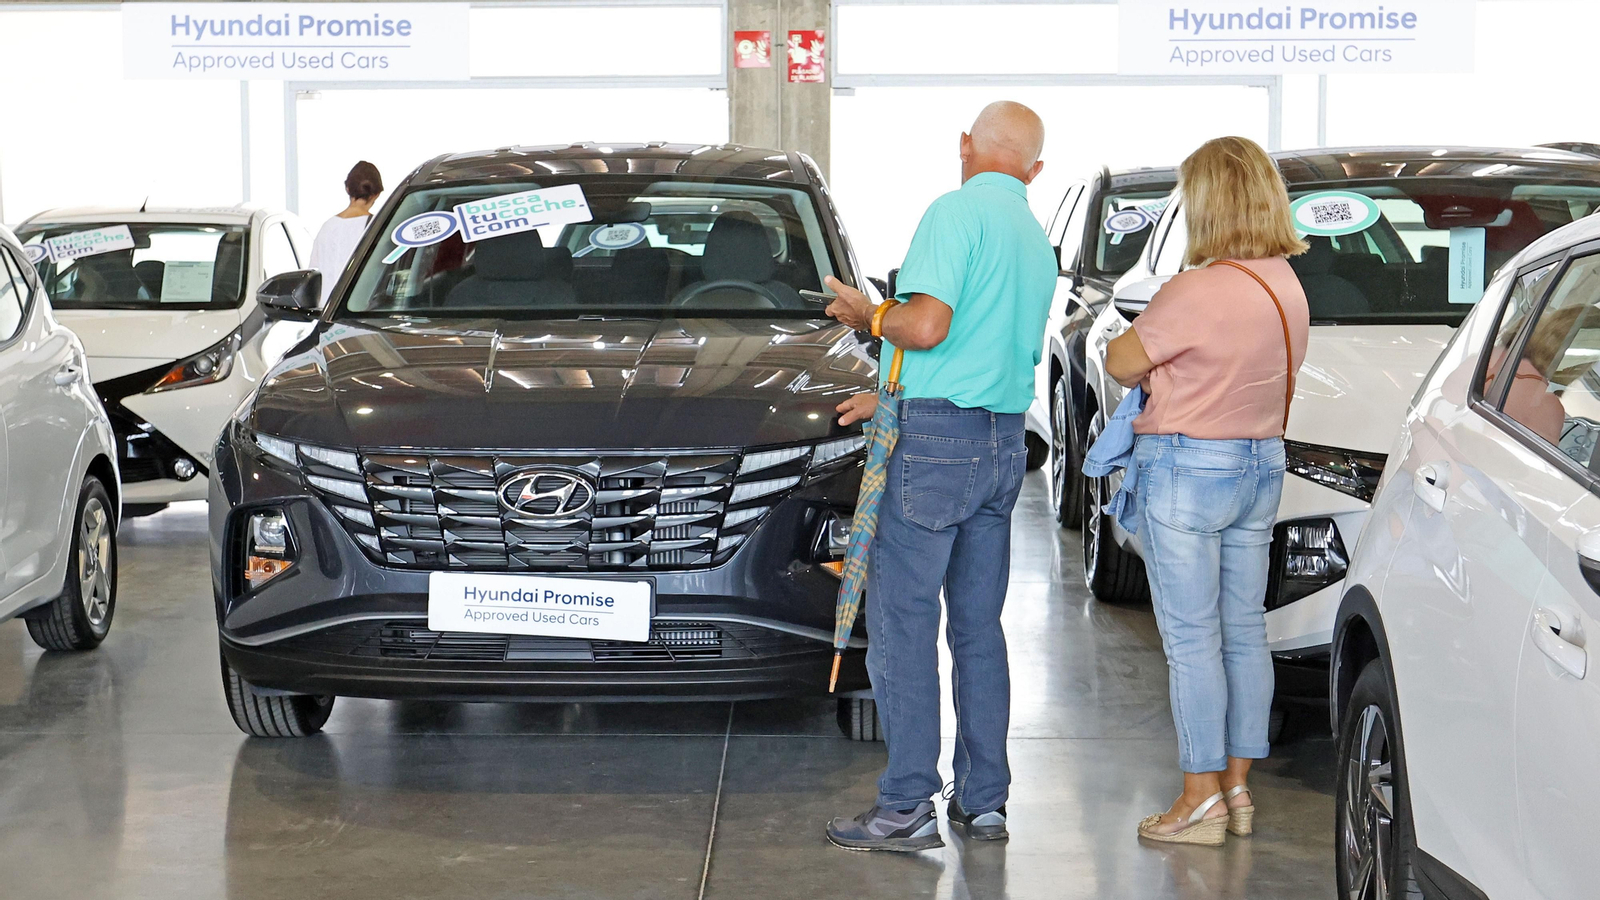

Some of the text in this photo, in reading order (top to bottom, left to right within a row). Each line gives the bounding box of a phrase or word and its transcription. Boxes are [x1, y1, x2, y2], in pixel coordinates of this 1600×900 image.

[171, 13, 412, 40] Hyundai Promise
[1168, 5, 1417, 35] Hyundai Promise
[172, 51, 389, 72] Approved Used Cars
[1169, 44, 1393, 67] Approved Used Cars
[465, 194, 541, 215] busca
[52, 231, 102, 246] busca
[464, 586, 615, 608] Hyundai Promise
[464, 608, 599, 626] Approved Used Cars
